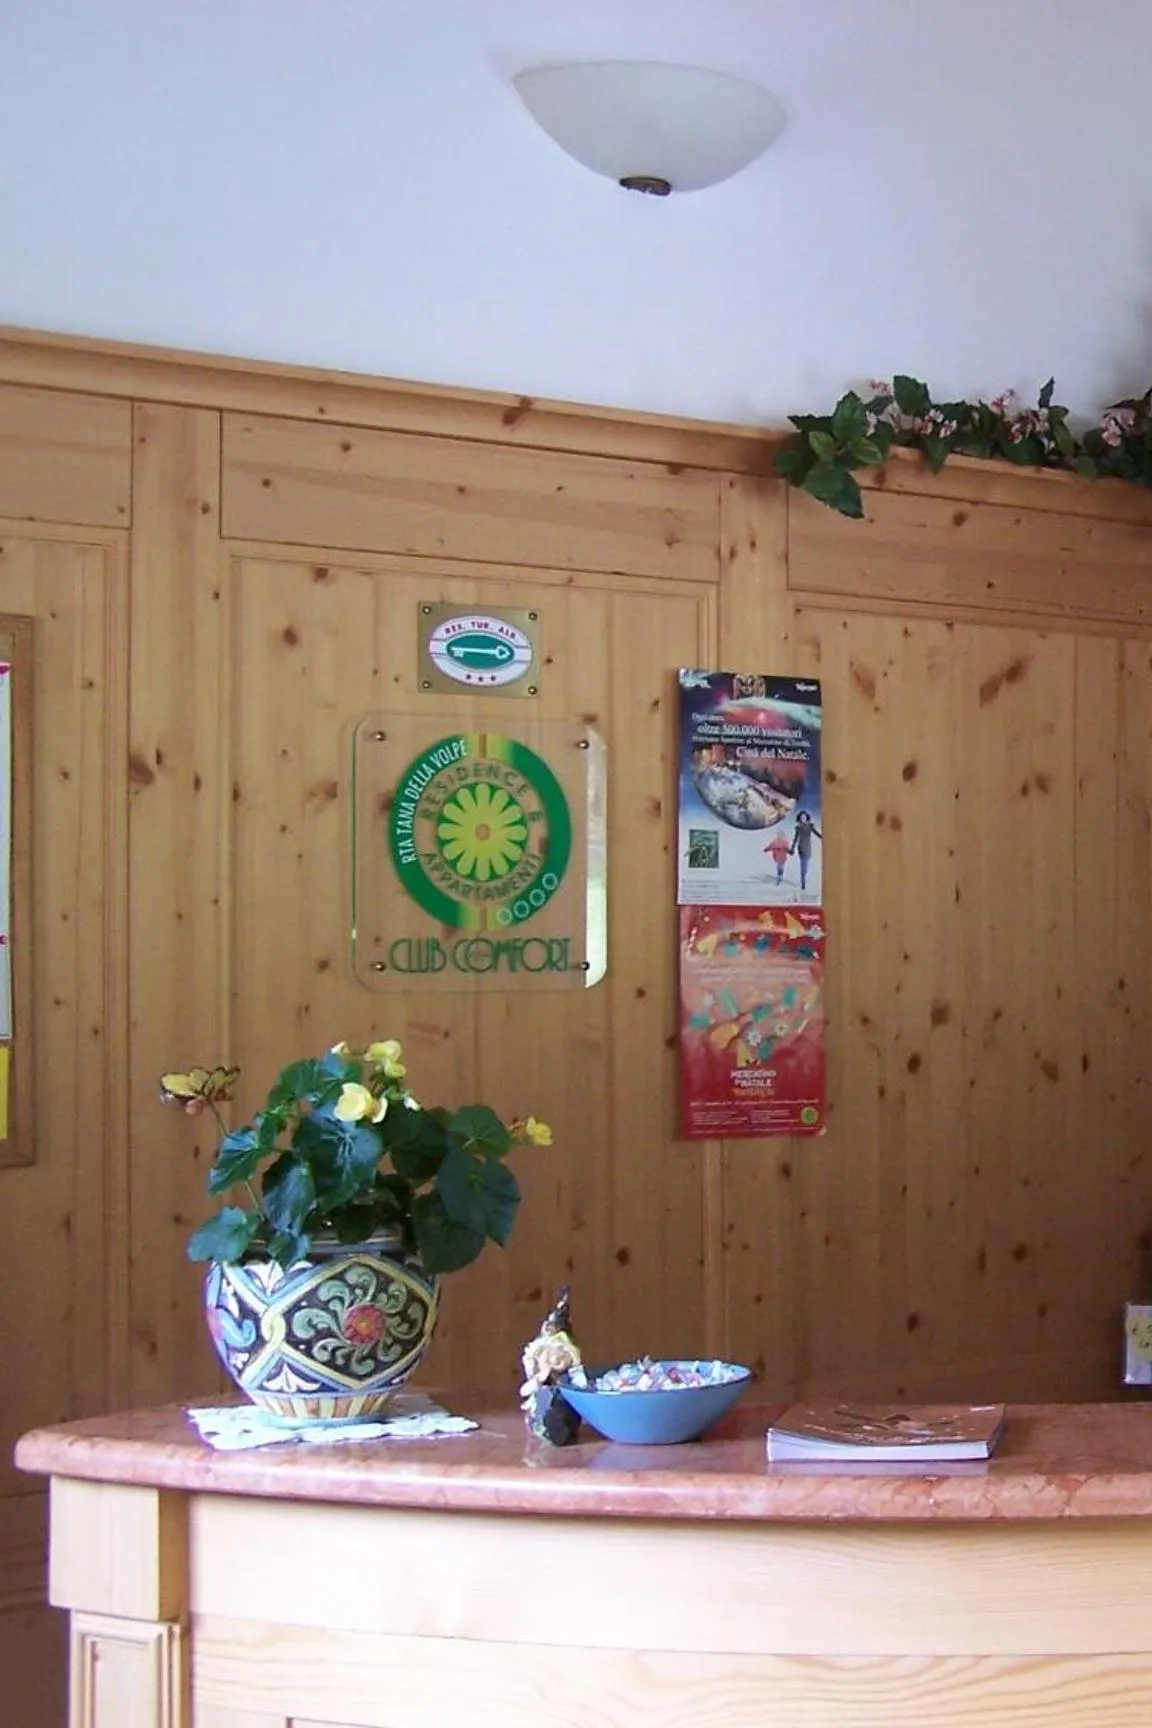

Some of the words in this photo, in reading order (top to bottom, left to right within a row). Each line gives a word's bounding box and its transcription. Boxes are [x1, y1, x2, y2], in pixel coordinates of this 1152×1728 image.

[429, 739, 468, 769] VOLPE
[404, 763, 436, 800] DELLA
[419, 763, 530, 822] RESIDENCE
[396, 801, 416, 836] TANA
[398, 837, 418, 865] RTA
[418, 852, 542, 901] APPARTAMENTI
[389, 936, 448, 974] CLUB
[452, 936, 572, 974] COMFORT
